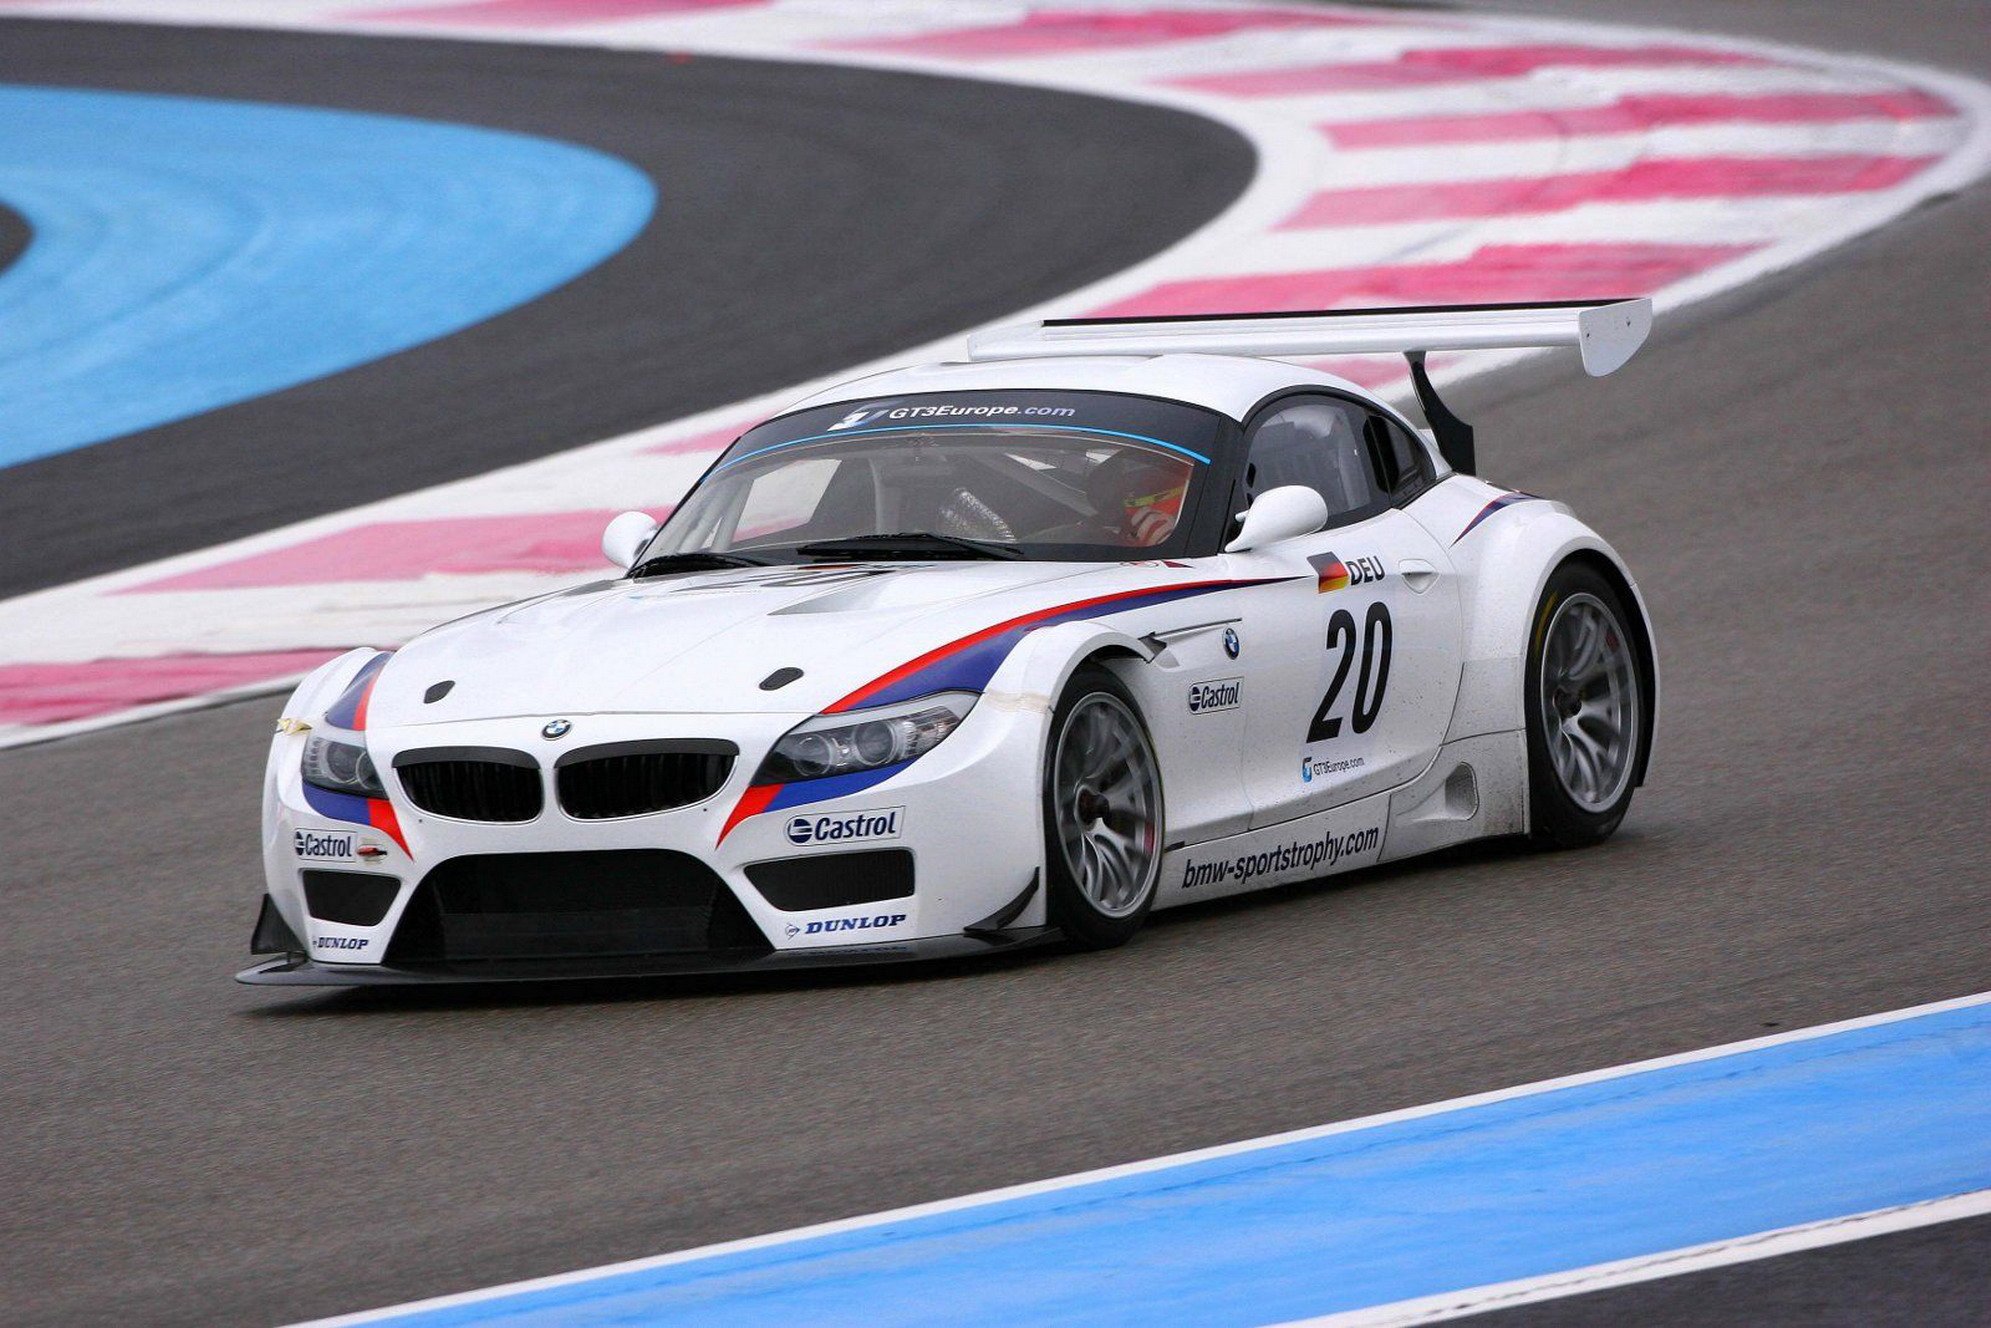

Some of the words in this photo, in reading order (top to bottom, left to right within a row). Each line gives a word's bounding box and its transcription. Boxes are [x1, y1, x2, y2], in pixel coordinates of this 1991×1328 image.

[889, 405, 1076, 420] GT3Europe.com
[1346, 555, 1386, 586] DEU
[1306, 601, 1393, 743] 20
[1200, 682, 1239, 709] Castrol
[814, 811, 896, 841] Castrol
[305, 834, 352, 858] Castrol
[1181, 826, 1379, 889] bmw-sportstrophy.com
[805, 914, 906, 935] DUNLOP
[318, 937, 369, 950] DUNLOP
